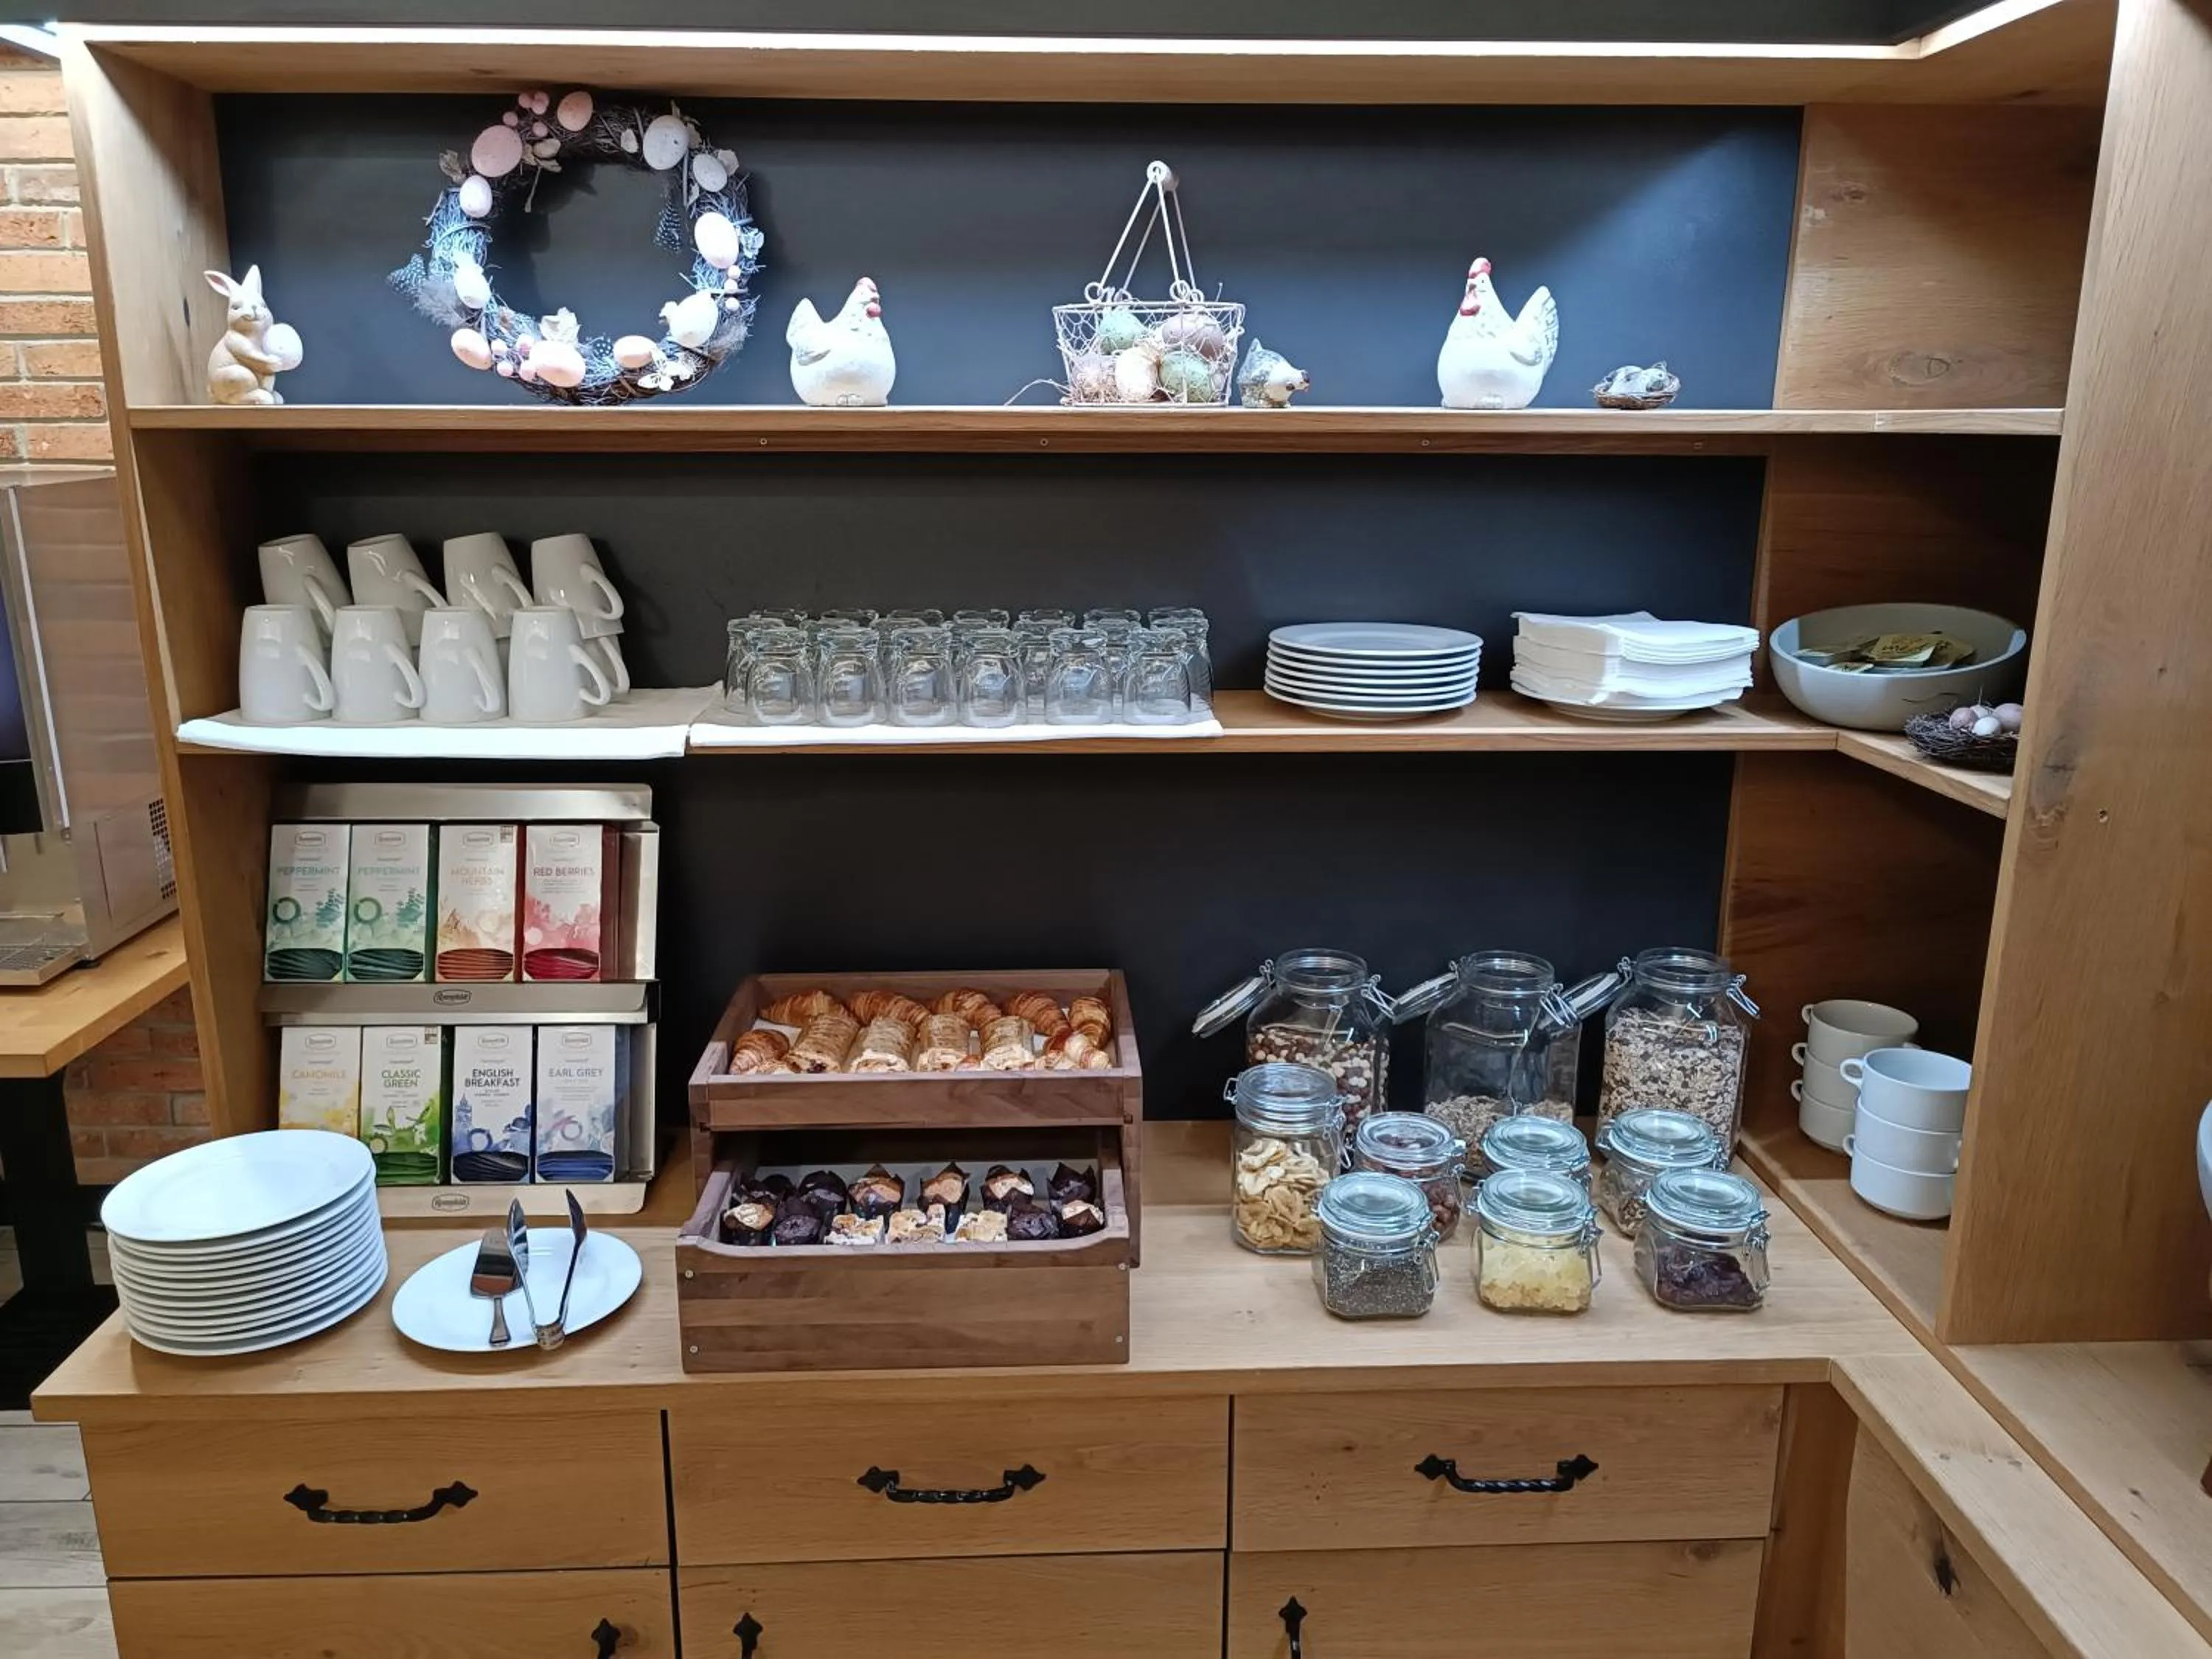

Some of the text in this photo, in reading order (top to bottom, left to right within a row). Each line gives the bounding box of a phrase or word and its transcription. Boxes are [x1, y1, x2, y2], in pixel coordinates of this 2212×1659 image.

[276, 866, 341, 875] PEPPERMINT
[358, 866, 420, 875] PEPPERMINT
[450, 867, 504, 876] MOUNTAIN
[533, 867, 595, 877] RED BERRIES
[381, 1069, 421, 1079] CLASSIC
[472, 1068, 514, 1077] ENGLISH
[549, 1068, 603, 1077] EARL GREY
[383, 1079, 418, 1088] GREEN
[465, 1078, 520, 1087] BREAKFAST
